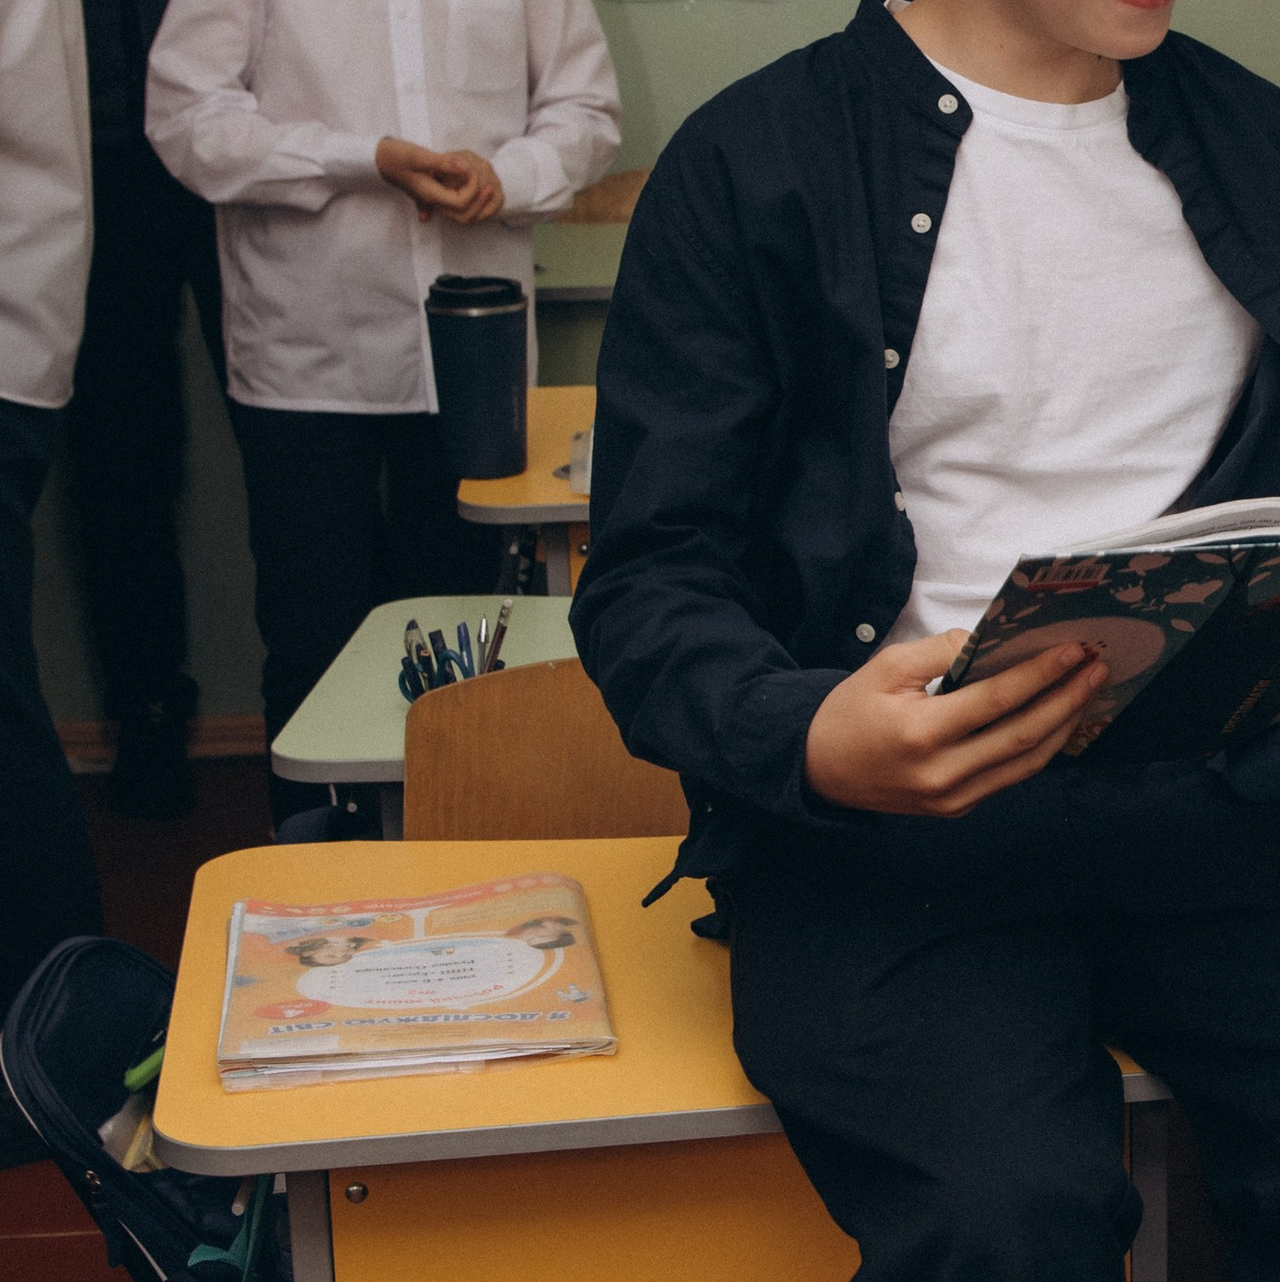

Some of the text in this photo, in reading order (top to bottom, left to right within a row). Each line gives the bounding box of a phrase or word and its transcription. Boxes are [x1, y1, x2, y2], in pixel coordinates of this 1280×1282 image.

[269, 1011, 572, 1035] Я ДОСЛІДЖУЮ СВІТ
